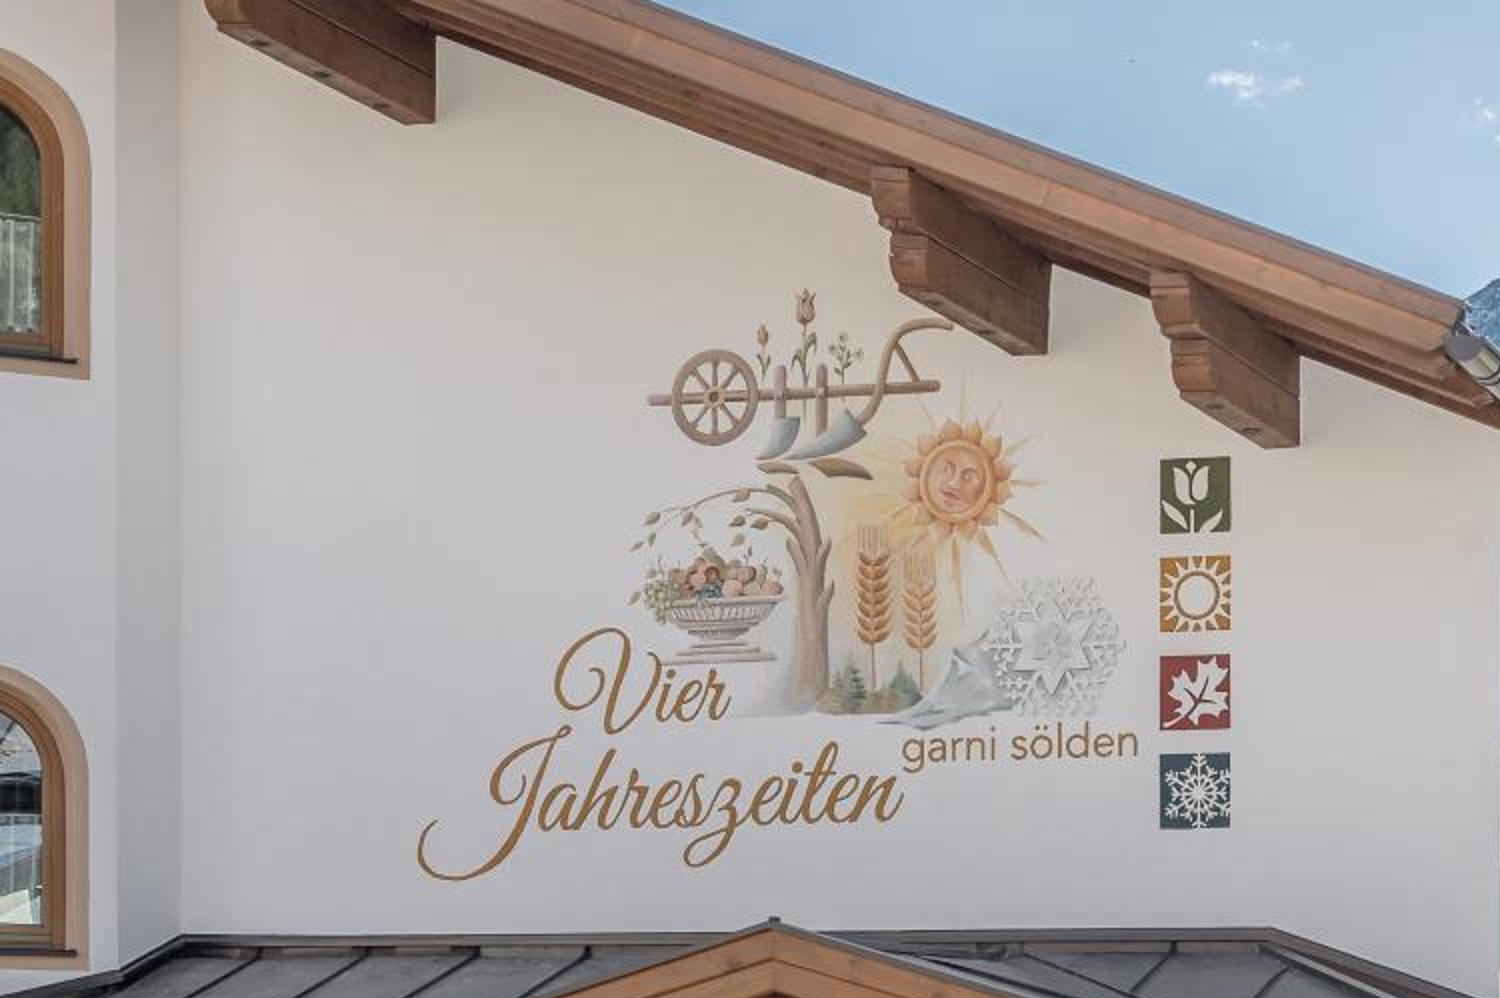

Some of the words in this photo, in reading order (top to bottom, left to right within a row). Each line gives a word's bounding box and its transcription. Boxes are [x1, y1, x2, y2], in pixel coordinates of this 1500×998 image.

[554, 628, 730, 735] Vier
[903, 726, 997, 773] garni
[1010, 721, 1139, 761] sölden
[417, 725, 904, 881] Jahreszeiten
